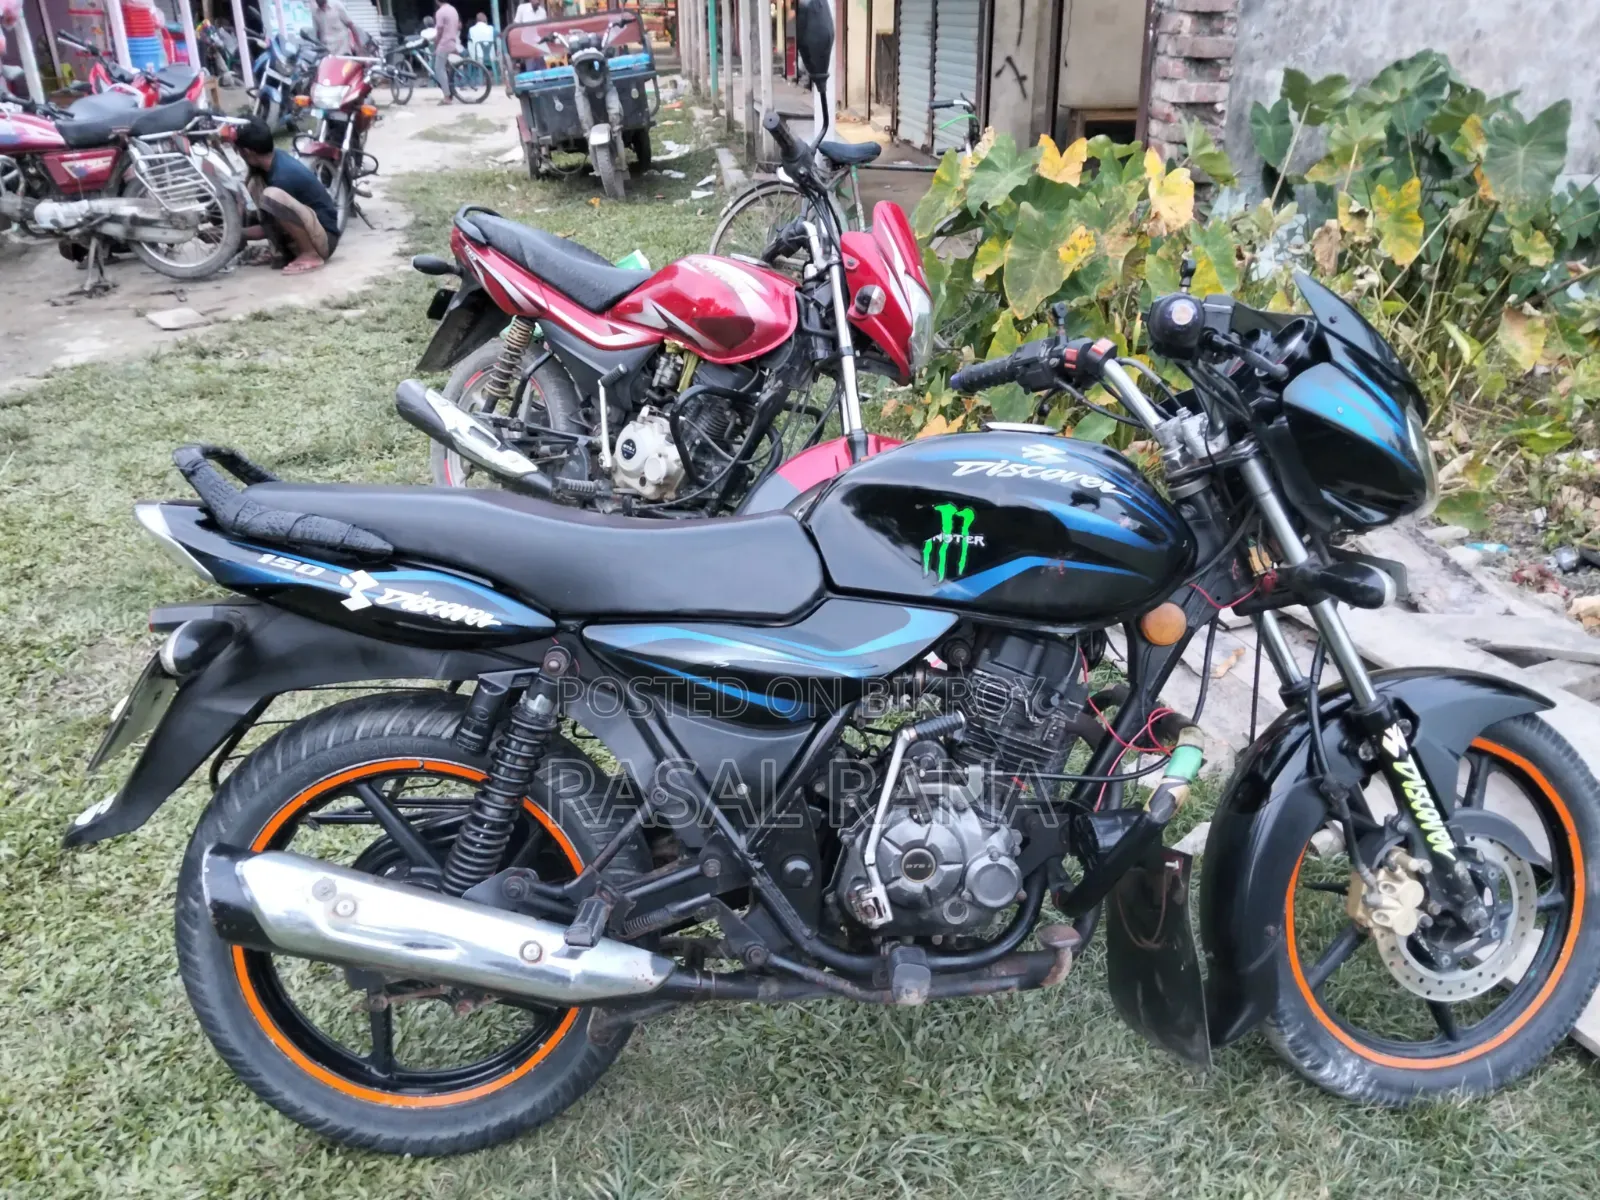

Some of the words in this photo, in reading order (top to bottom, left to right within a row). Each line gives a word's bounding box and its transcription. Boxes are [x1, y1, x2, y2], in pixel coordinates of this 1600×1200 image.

[952, 460, 1131, 498] Discover
[257, 554, 325, 576] 150
[375, 587, 502, 628] Discover
